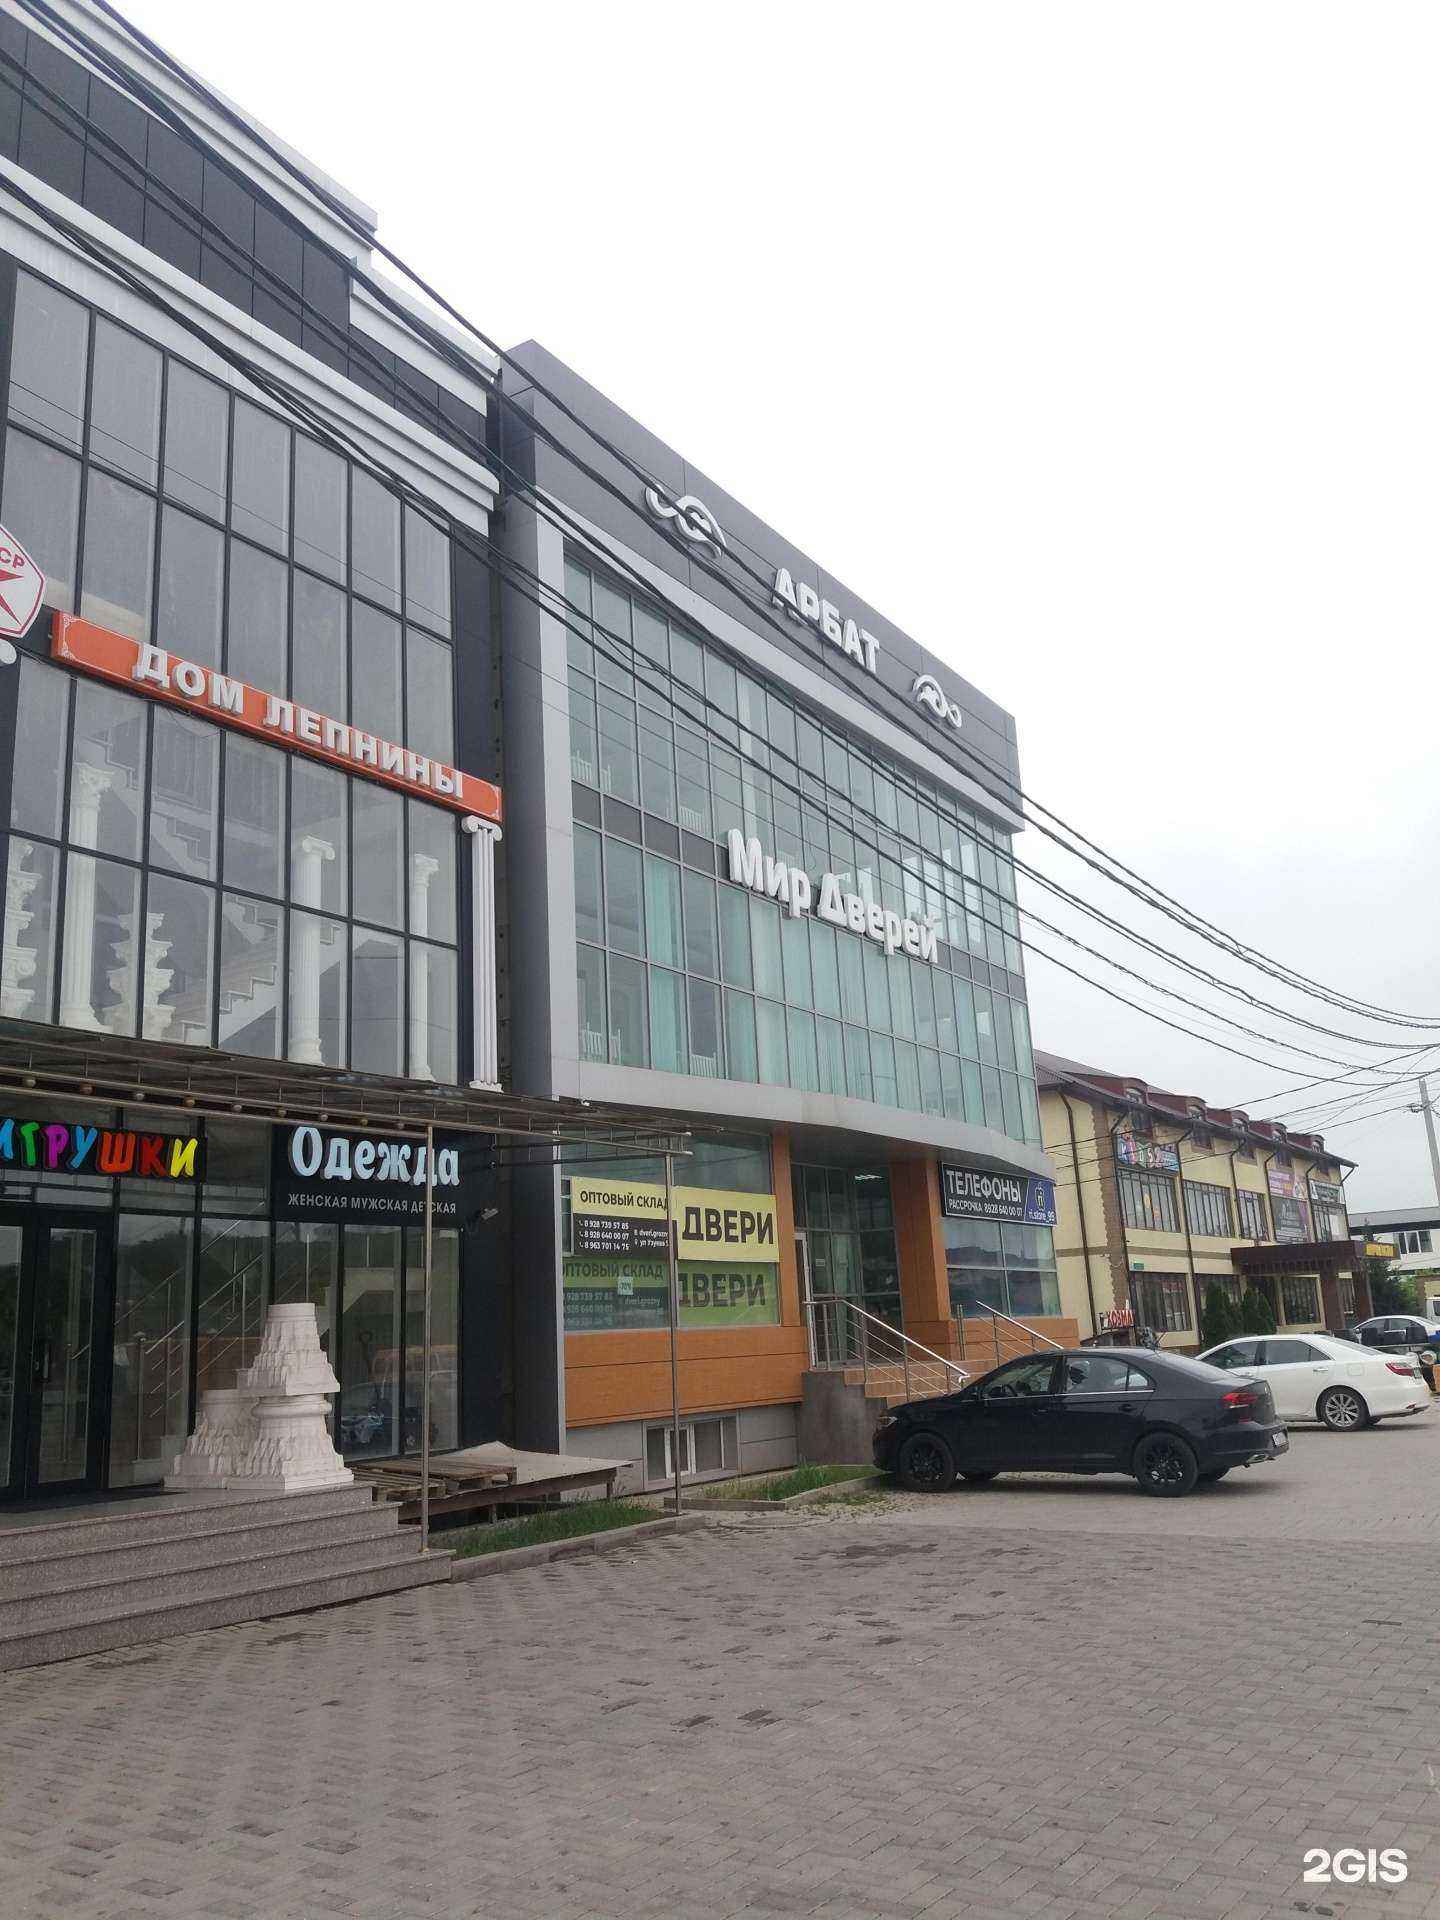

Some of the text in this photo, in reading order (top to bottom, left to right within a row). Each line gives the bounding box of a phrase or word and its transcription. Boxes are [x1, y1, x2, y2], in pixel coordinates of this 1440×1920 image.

[771, 567, 880, 674] АРБАТ
[132, 641, 463, 799] ДОМ ЛЕПНИНЫ
[727, 828, 938, 963] Мир Дверей
[290, 1126, 460, 1187] Одежда
[580, 1190, 634, 1206] ОПТОВЫЙ
[946, 1170, 1022, 1203] ТЕЛЕФОНЫ
[288, 1193, 348, 1208] ЖЕНСКАЯ
[351, 1197, 408, 1212] МУЖСКАЯ
[948, 1198, 983, 1213] РАССРОЧКА
[584, 1230, 589, 1238] 8
[589, 1231, 601, 1239] 928
[682, 1206, 774, 1245] ДВЕРИ
[584, 1241, 589, 1249] 8
[623, 1264, 663, 1280] СКЛАД
